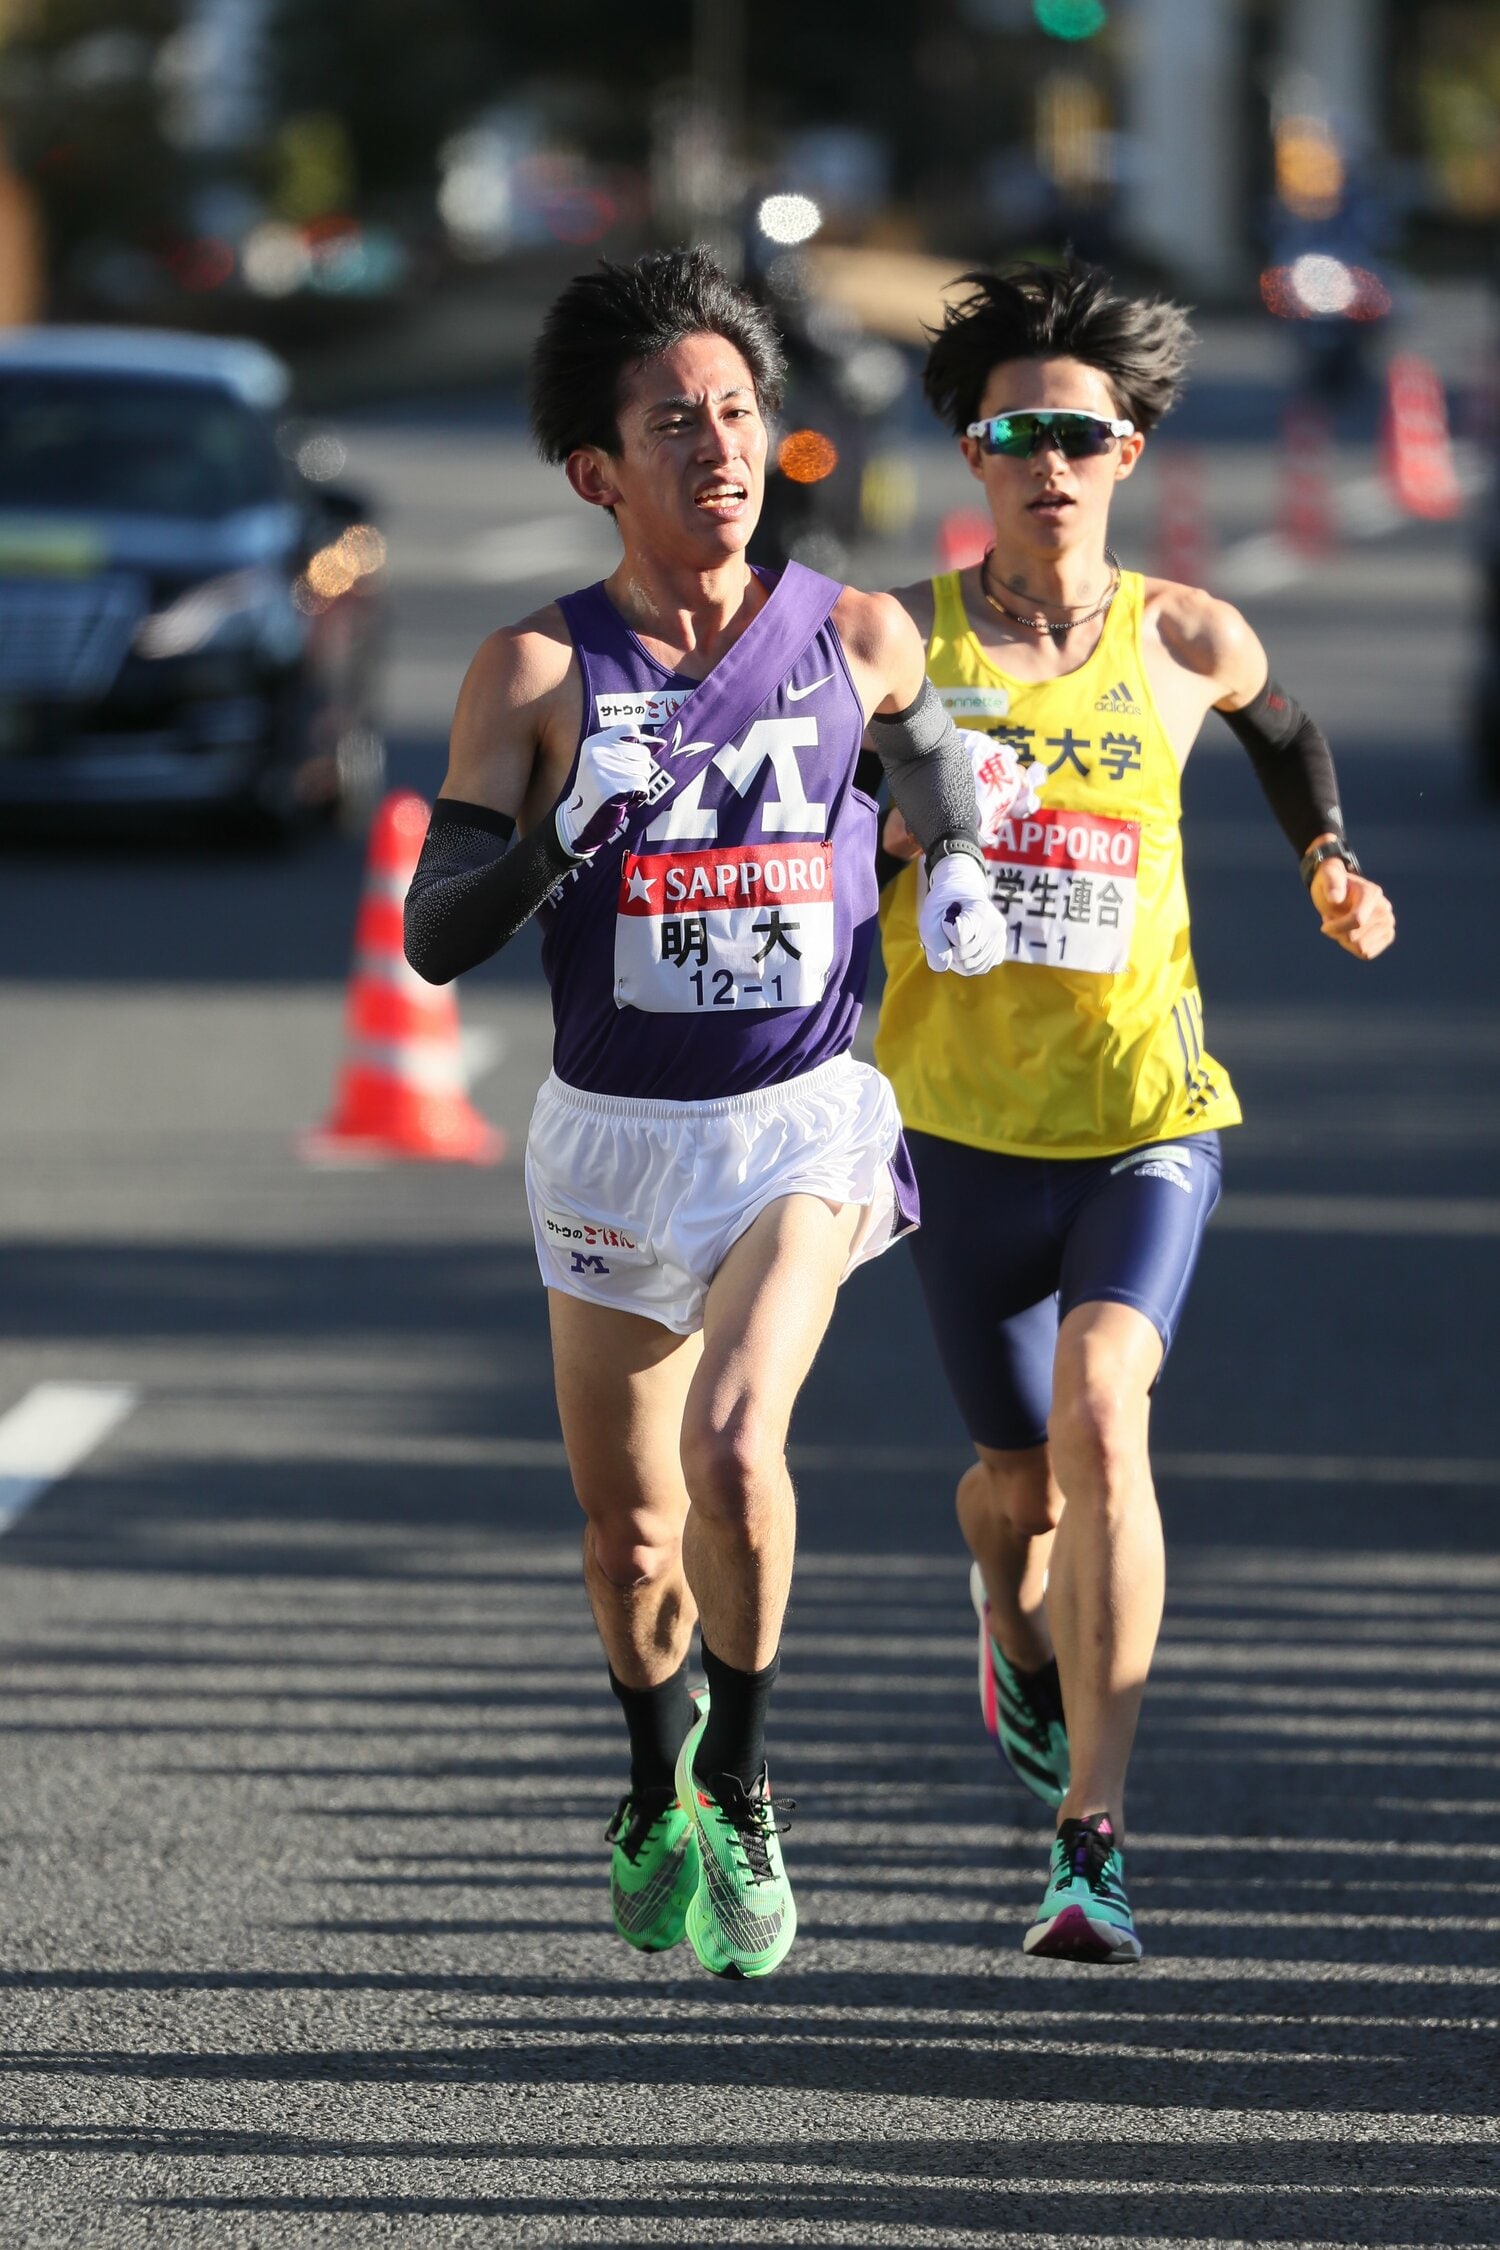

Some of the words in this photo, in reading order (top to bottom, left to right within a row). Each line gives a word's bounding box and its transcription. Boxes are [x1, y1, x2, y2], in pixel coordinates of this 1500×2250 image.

[600, 696, 689, 719] サトウのごは
[1094, 699, 1142, 716] adidas
[992, 818, 1134, 866] APPORO
[665, 856, 826, 901] SAPPORO
[986, 868, 1124, 929] 学生連合
[689, 969, 783, 1006] 12-1
[546, 1219, 635, 1249] サトウのごはん
[570, 1251, 610, 1274] M
